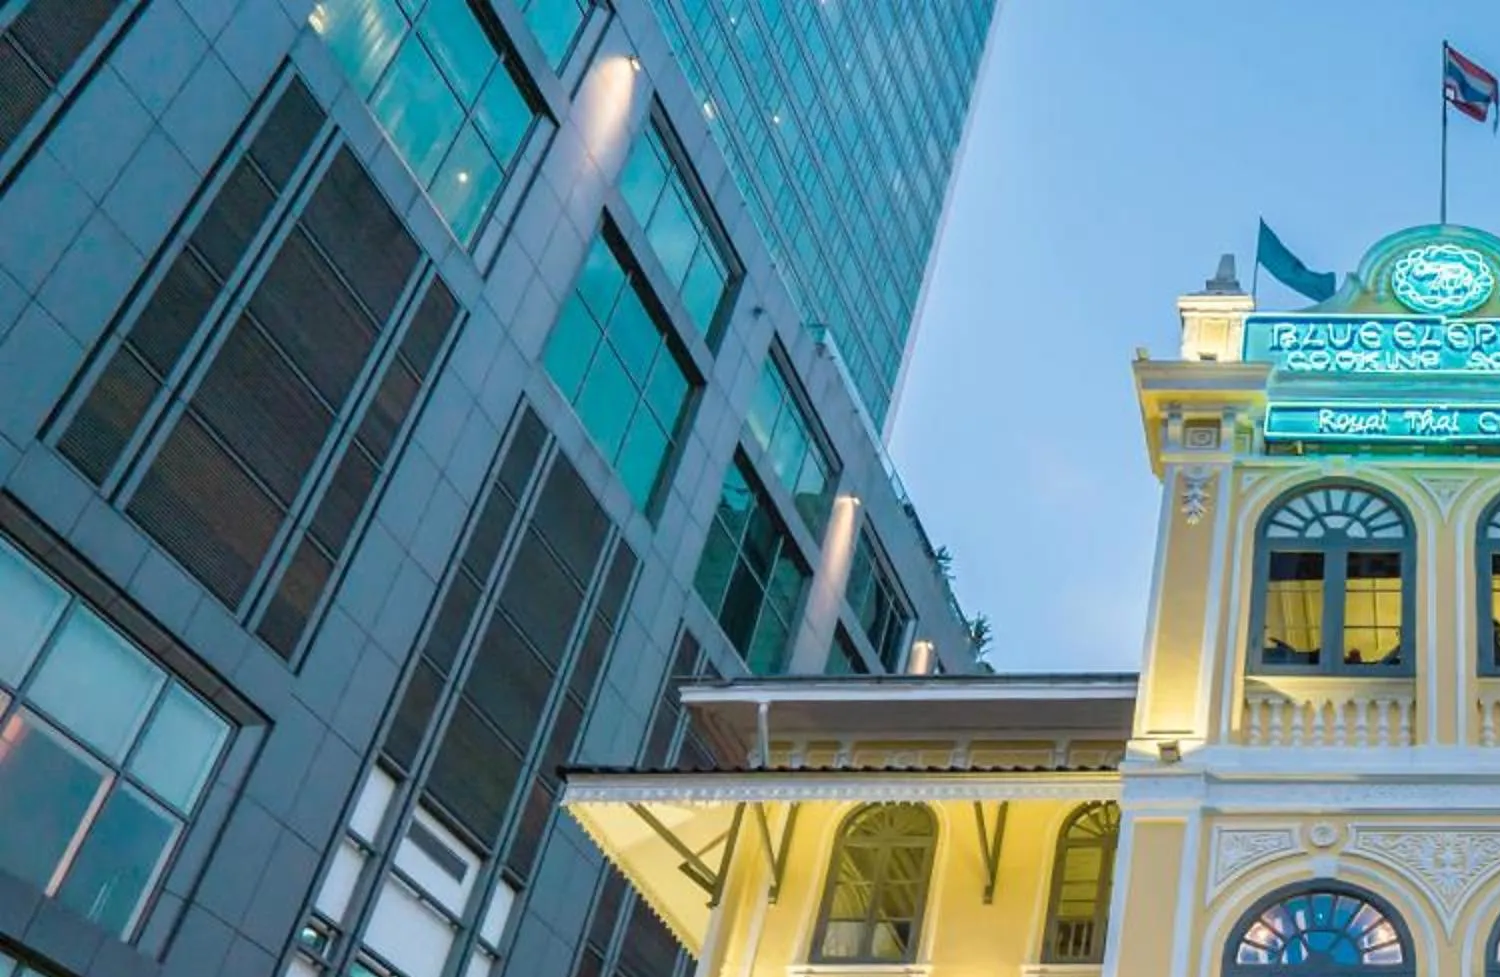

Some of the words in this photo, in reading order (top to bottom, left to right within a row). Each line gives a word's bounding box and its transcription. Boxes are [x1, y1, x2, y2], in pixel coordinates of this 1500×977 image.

[1270, 321, 1383, 351] BLUE
[1286, 350, 1441, 371] COOKING
[1318, 408, 1389, 434] Royal
[1404, 409, 1460, 434] Thai
